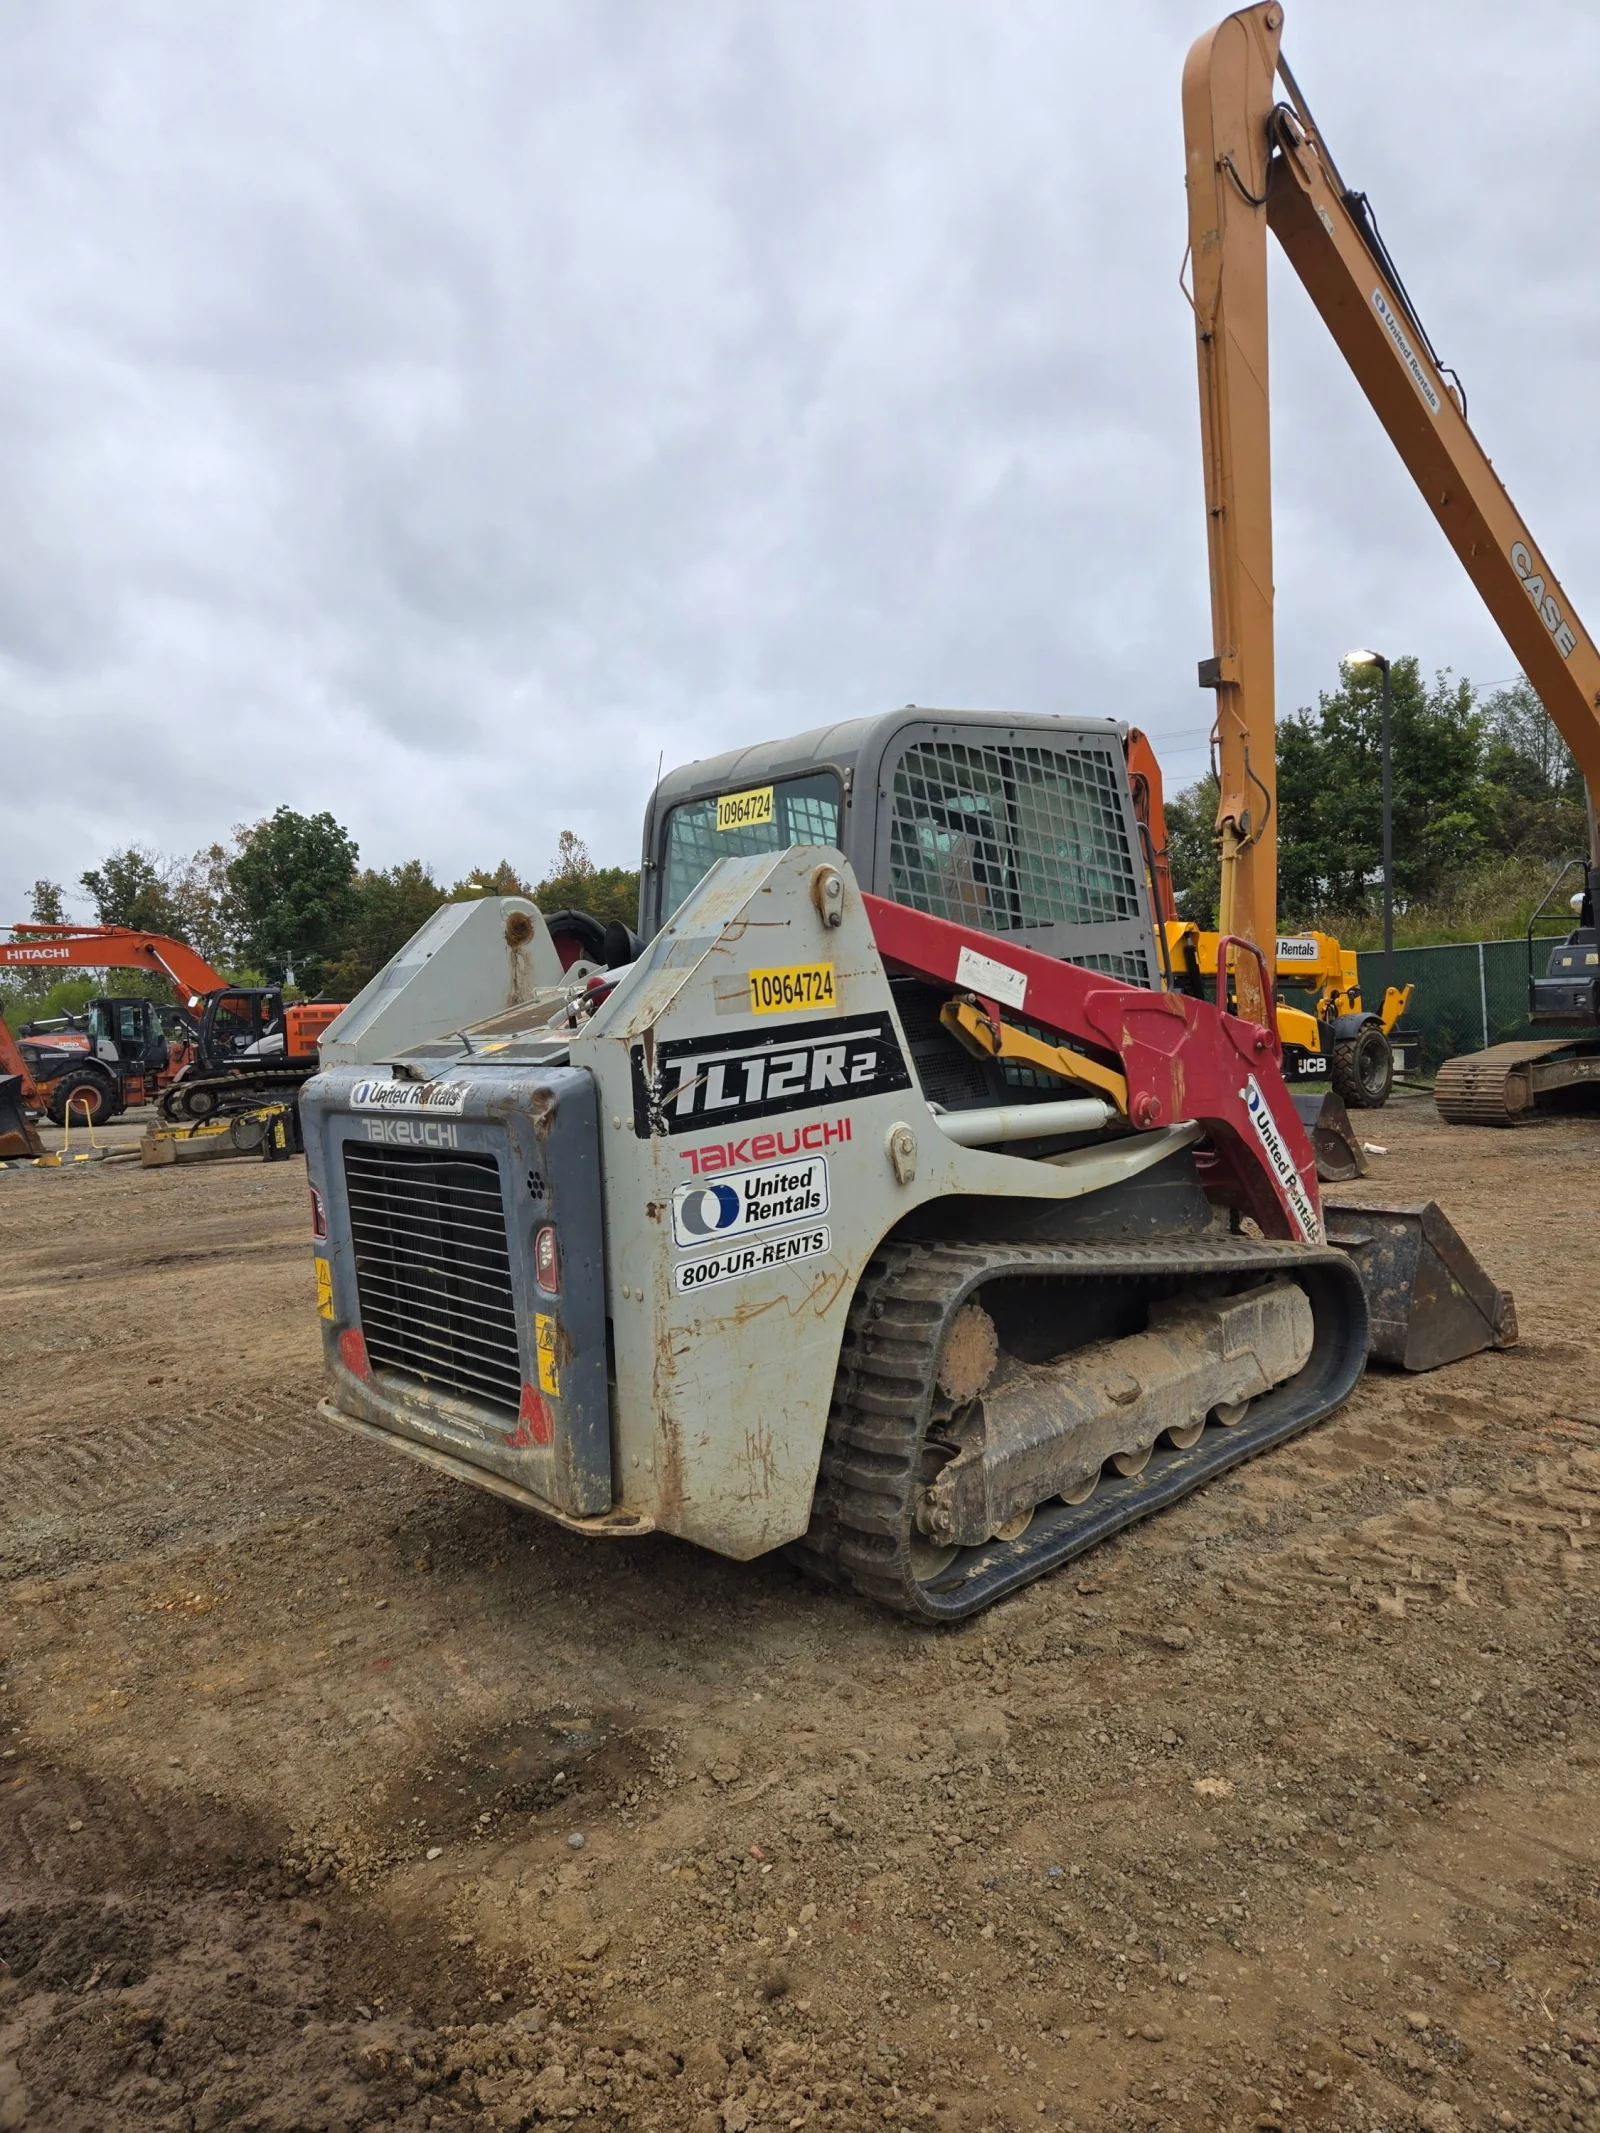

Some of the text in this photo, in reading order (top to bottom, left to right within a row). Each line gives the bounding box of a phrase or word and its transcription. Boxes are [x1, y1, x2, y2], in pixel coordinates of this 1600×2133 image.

[1385, 313, 1437, 407] United Rentals
[1510, 541, 1577, 660] CASE
[719, 793, 770, 825] 10964724
[6, 948, 70, 960] HITACHI
[1281, 942, 1314, 956] Rentals
[751, 970, 833, 1008] 10964724
[1298, 1057, 1327, 1074] JCB
[369, 1082, 457, 1106] United Rntals
[362, 1119, 458, 1147] TAKEUCHI
[679, 1117, 852, 1175] TAKEUCHI
[1256, 1111, 1289, 1176] United
[744, 1166, 813, 1200] United
[745, 1189, 821, 1224] Rentals
[682, 1232, 824, 1287] 800-UR-RENTS
